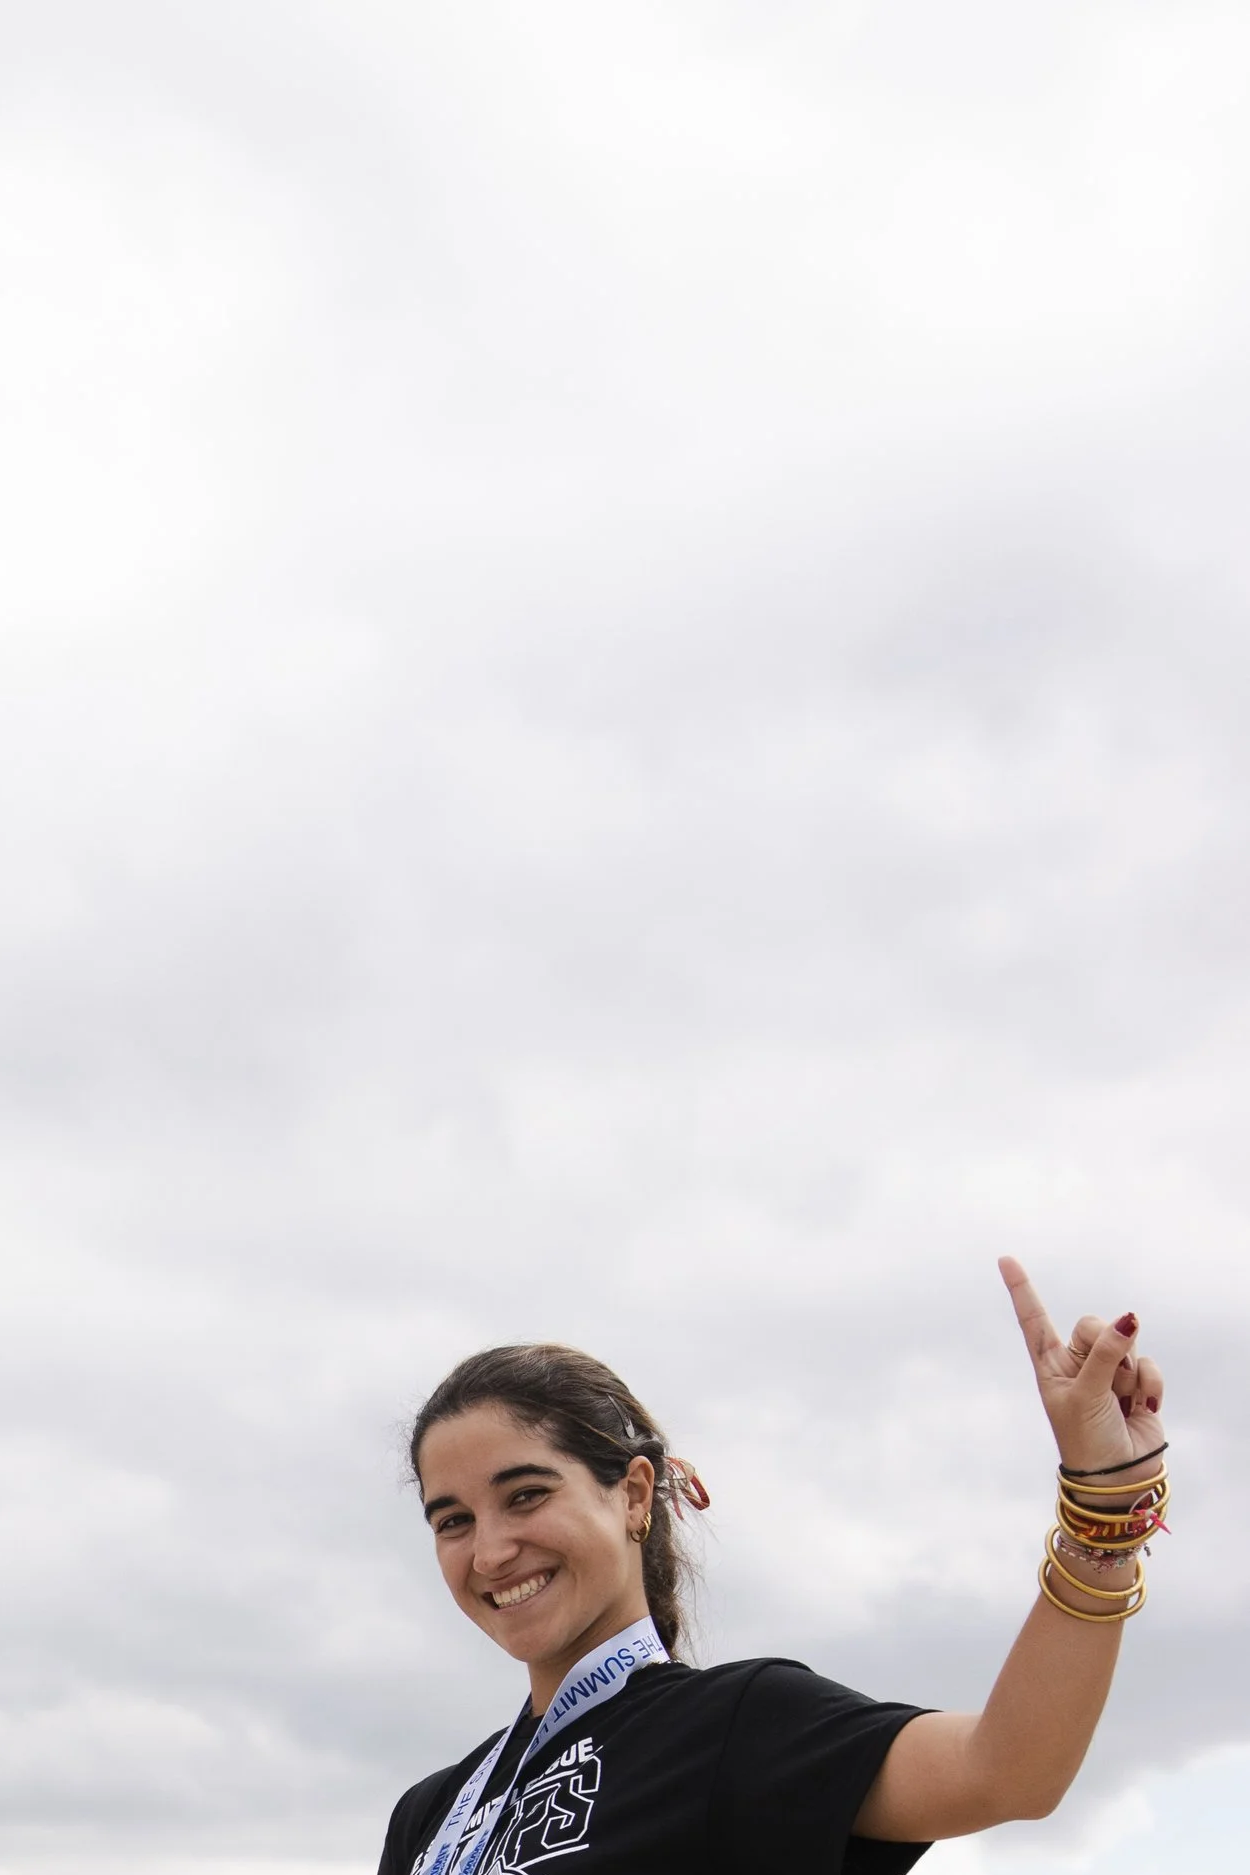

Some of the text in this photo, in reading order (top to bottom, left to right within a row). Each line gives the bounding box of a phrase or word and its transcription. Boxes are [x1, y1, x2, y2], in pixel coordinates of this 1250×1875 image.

[552, 1633, 662, 1723] THE SUMMIT
[445, 1788, 475, 1831] THE
